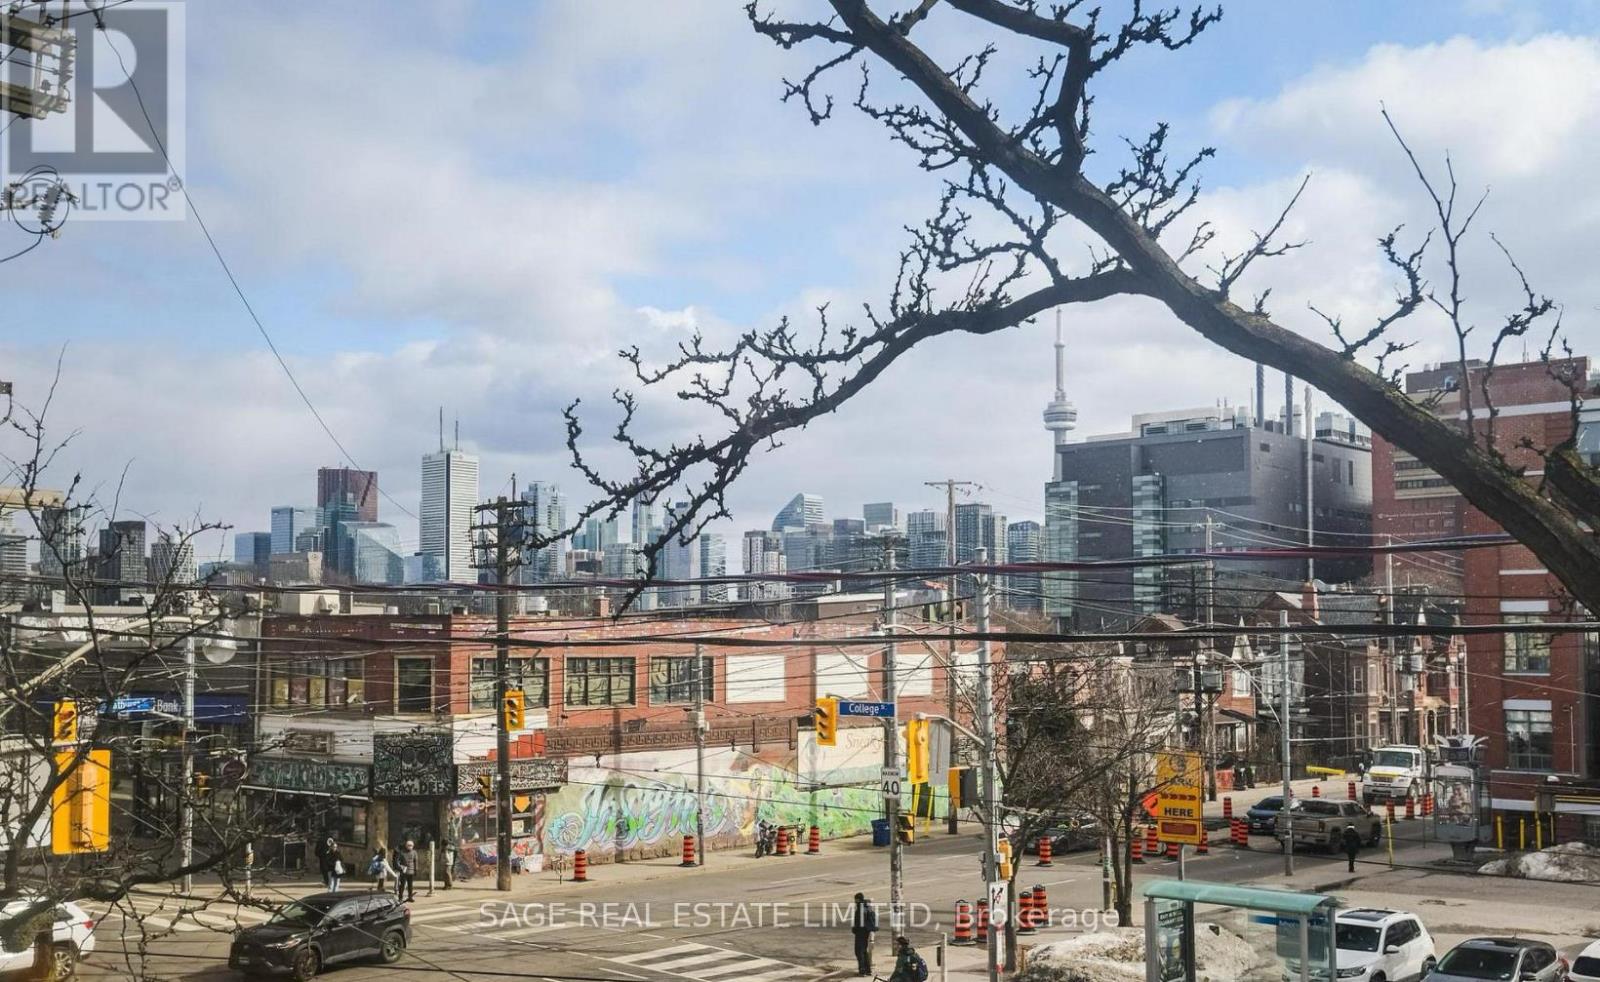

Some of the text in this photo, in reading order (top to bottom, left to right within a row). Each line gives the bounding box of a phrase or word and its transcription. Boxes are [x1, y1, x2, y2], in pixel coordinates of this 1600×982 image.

[156, 699, 180, 713] Bank
[848, 702, 880, 716] College
[883, 780, 900, 795] 40
[1164, 807, 1194, 818] HERE
